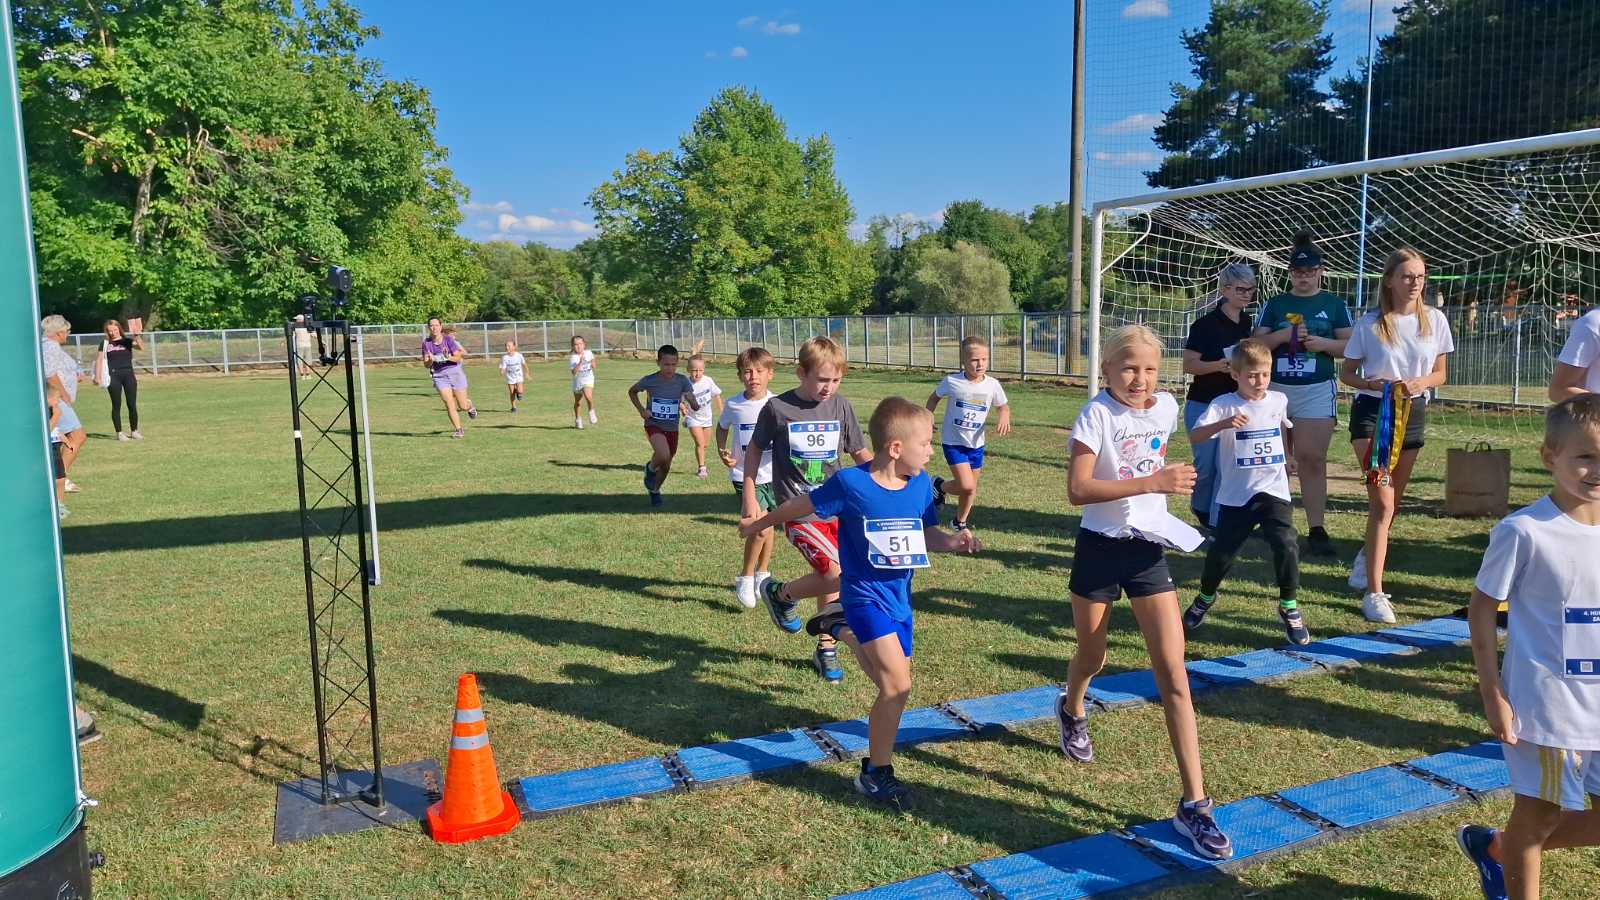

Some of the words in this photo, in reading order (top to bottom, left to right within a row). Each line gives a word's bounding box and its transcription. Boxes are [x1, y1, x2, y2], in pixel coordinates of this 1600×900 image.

[963, 412, 977, 421] 42
[807, 433, 826, 447] 96
[1114, 425, 1167, 443] Champion
[1253, 441, 1273, 455] 55
[889, 535, 911, 552] 51
